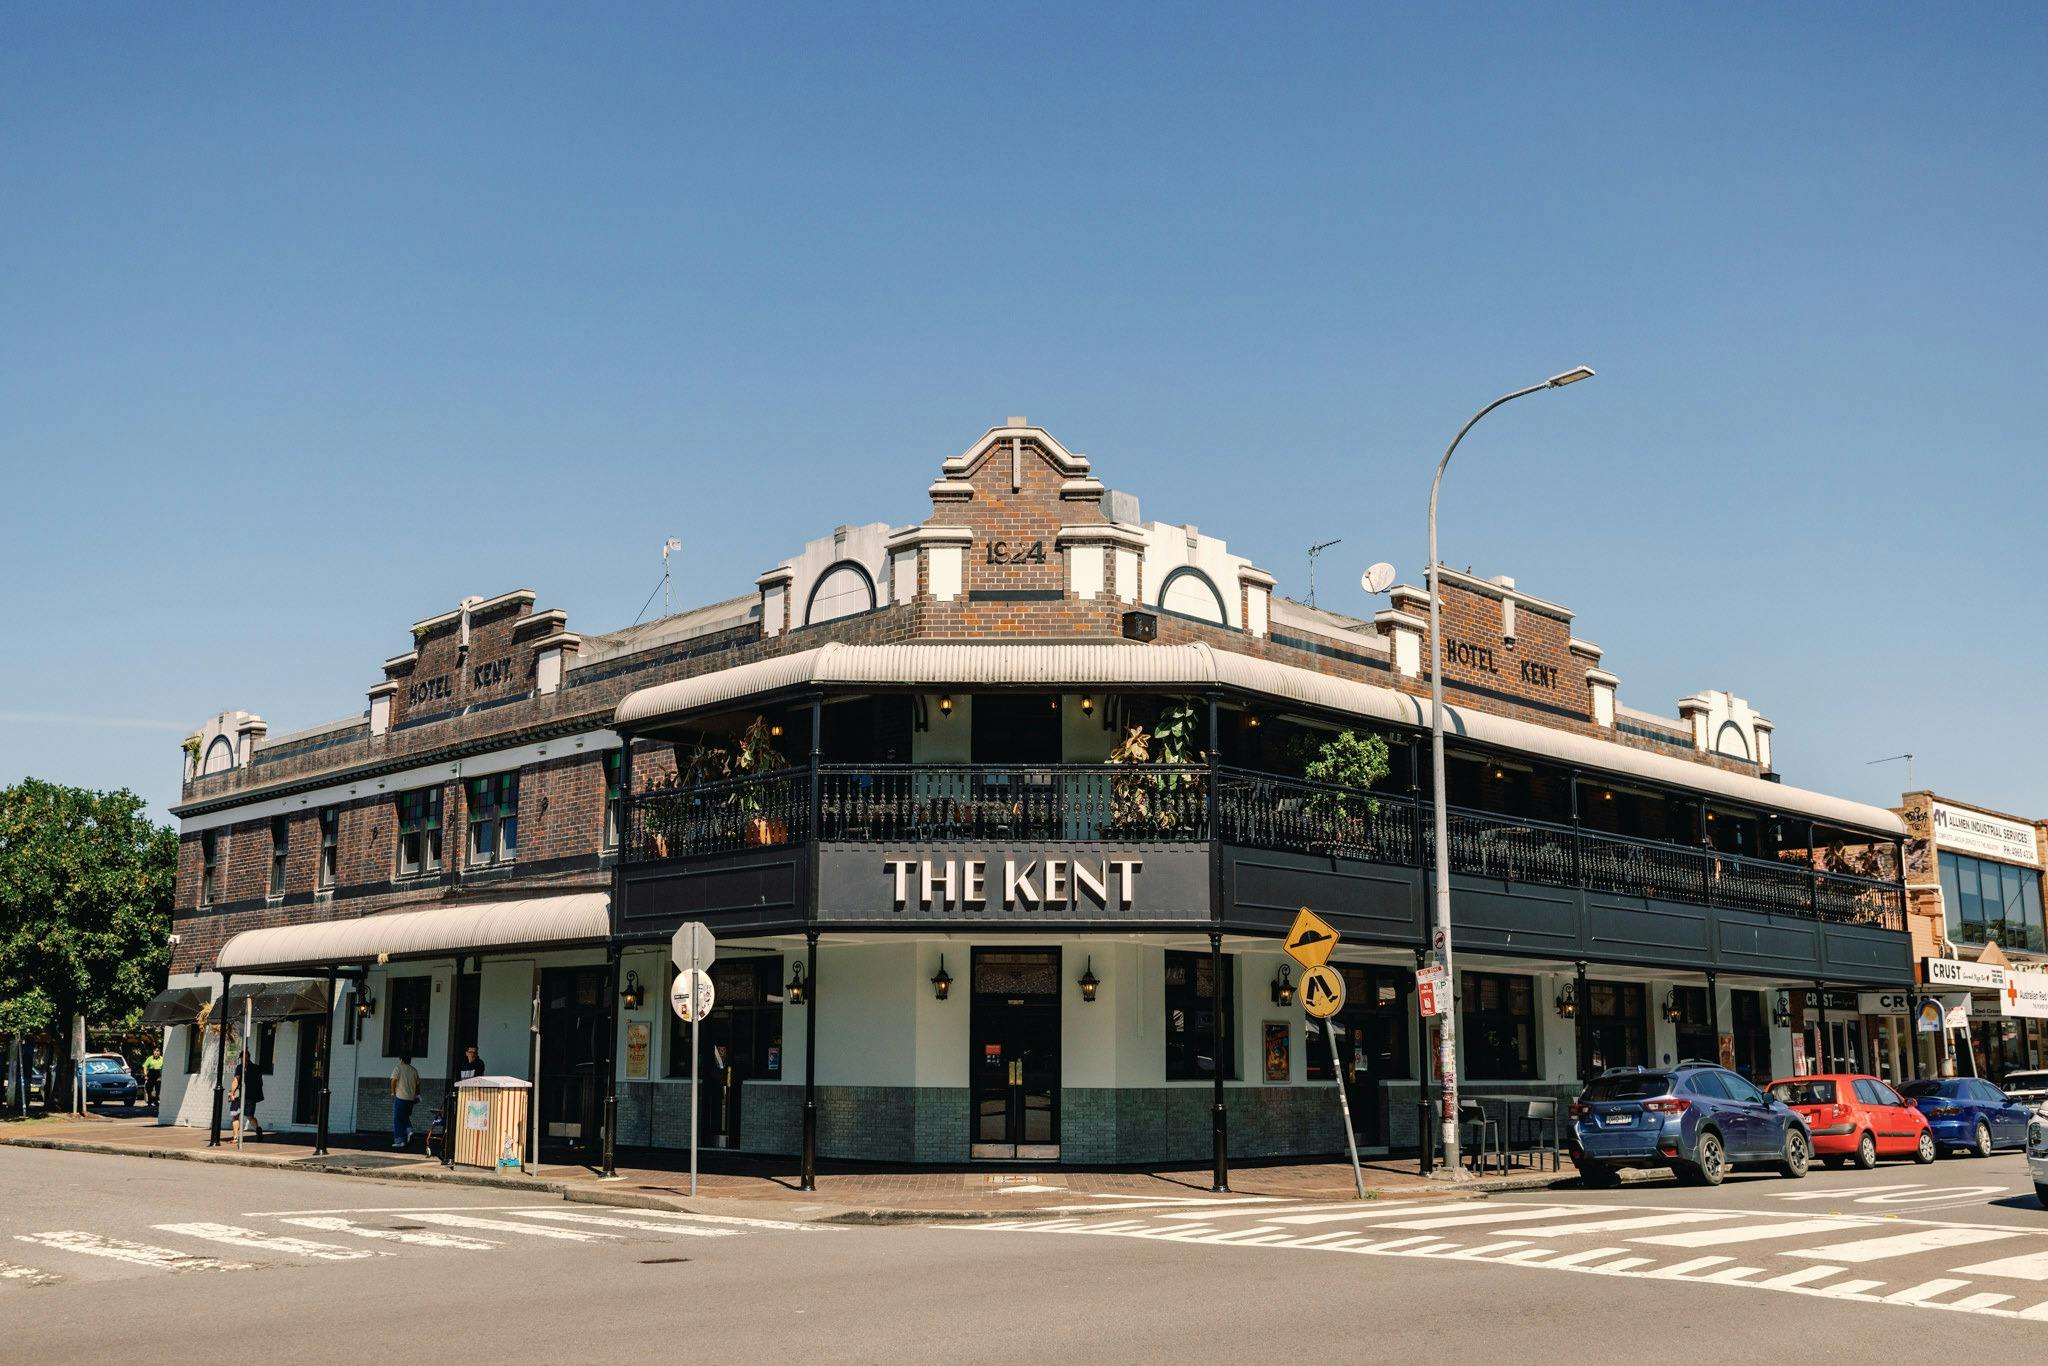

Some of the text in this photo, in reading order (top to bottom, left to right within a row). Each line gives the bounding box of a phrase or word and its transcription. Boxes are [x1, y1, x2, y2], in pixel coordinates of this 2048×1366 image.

[986, 541, 1047, 565] 1924
[1447, 638, 1558, 690] HOTEL KENT
[409, 674, 452, 708] HOTEL
[1949, 815, 1970, 830] ALLMEN
[1970, 820, 2002, 838] INDUSTRIAL
[2003, 828, 2028, 844] SERVICES
[885, 860, 1143, 905] THE KENT
[1933, 963, 1961, 980] CRUST
[1805, 992, 1834, 1007] CRST
[1880, 995, 1946, 1008] CRT
[2020, 989, 2038, 1000] Australian
[1764, 1184, 2010, 1203] 40
